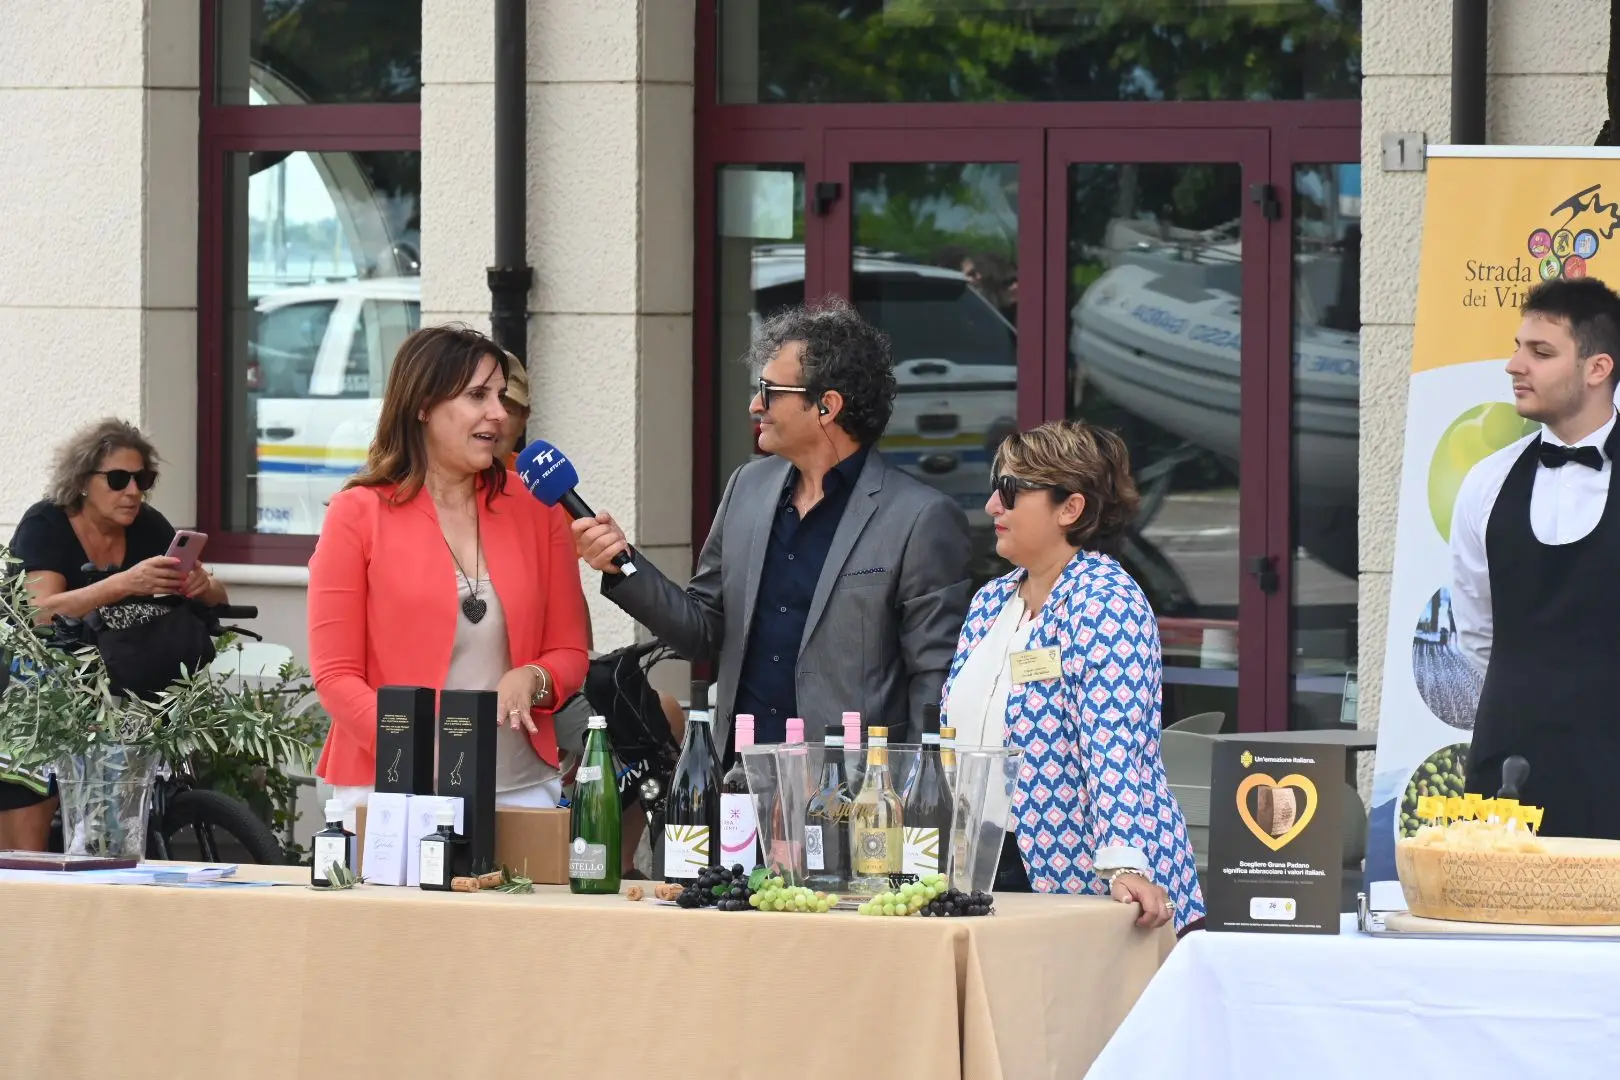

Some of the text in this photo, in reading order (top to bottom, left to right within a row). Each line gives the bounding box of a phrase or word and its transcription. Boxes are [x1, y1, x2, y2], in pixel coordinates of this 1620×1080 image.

[1397, 139, 1405, 166] 1
[1465, 257, 1532, 282] Strada
[1462, 289, 1488, 307] dei
